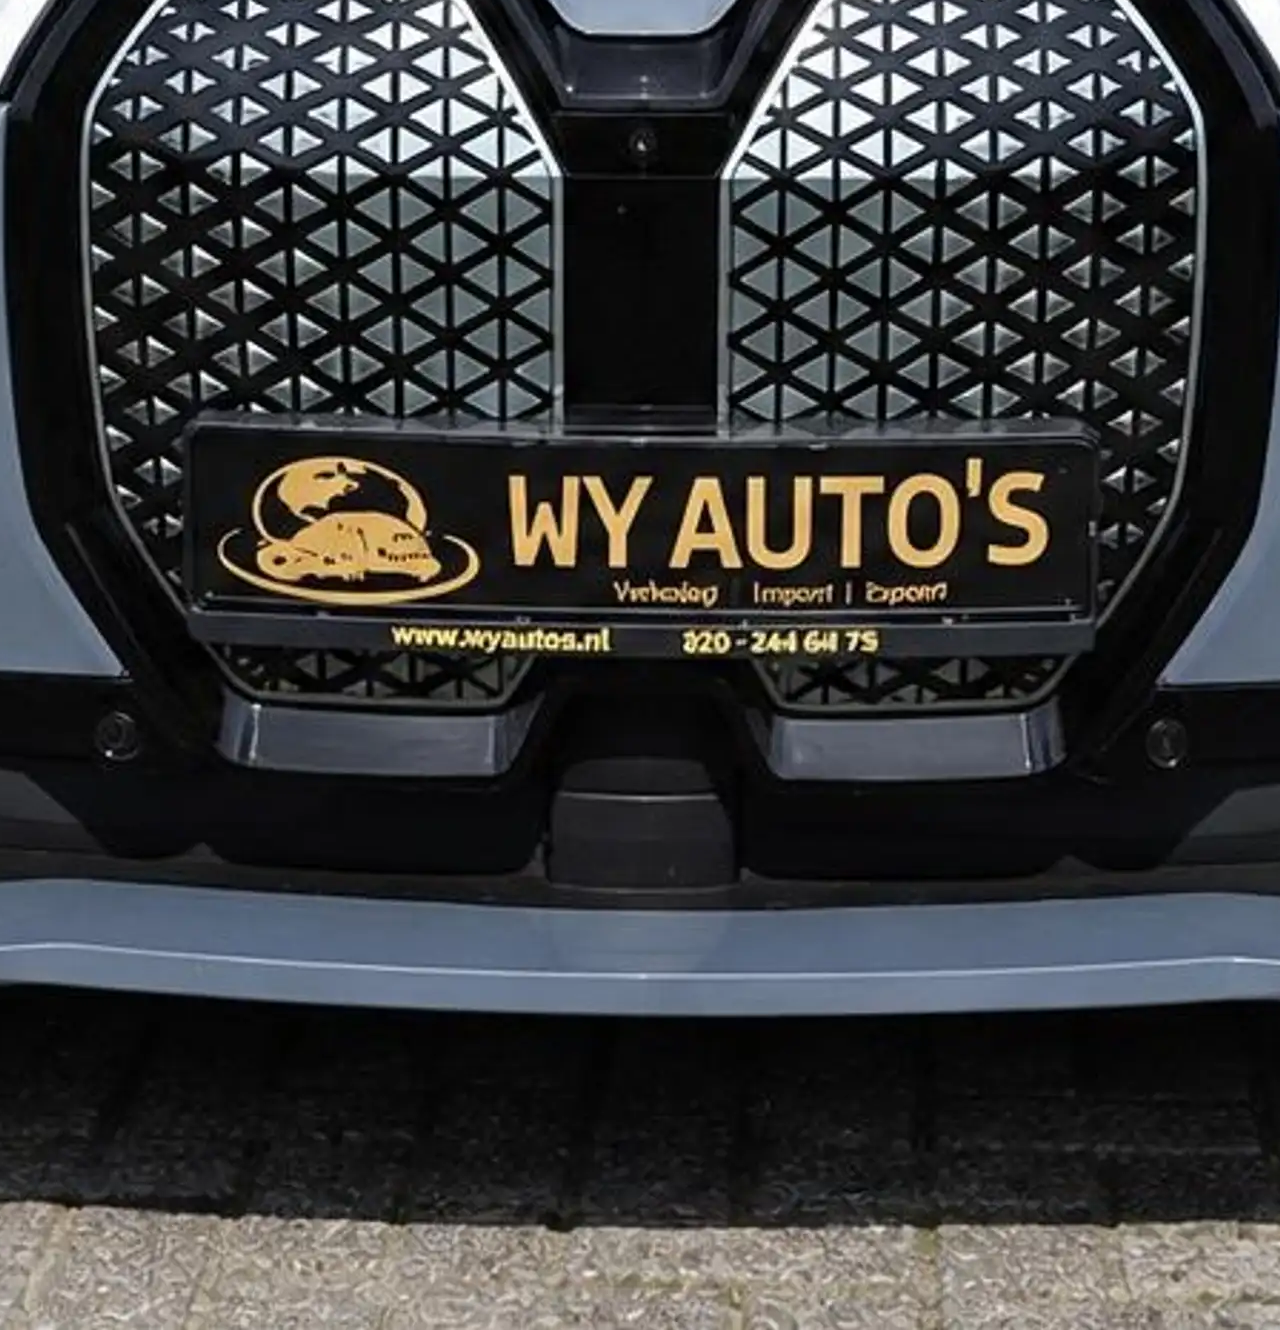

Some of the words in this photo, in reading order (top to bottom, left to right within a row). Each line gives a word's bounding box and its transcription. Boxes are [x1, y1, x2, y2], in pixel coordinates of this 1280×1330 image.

[508, 475, 653, 568] WY
[668, 457, 1049, 570] AUTO'S
[391, 625, 612, 654] www.wyautos.nl
